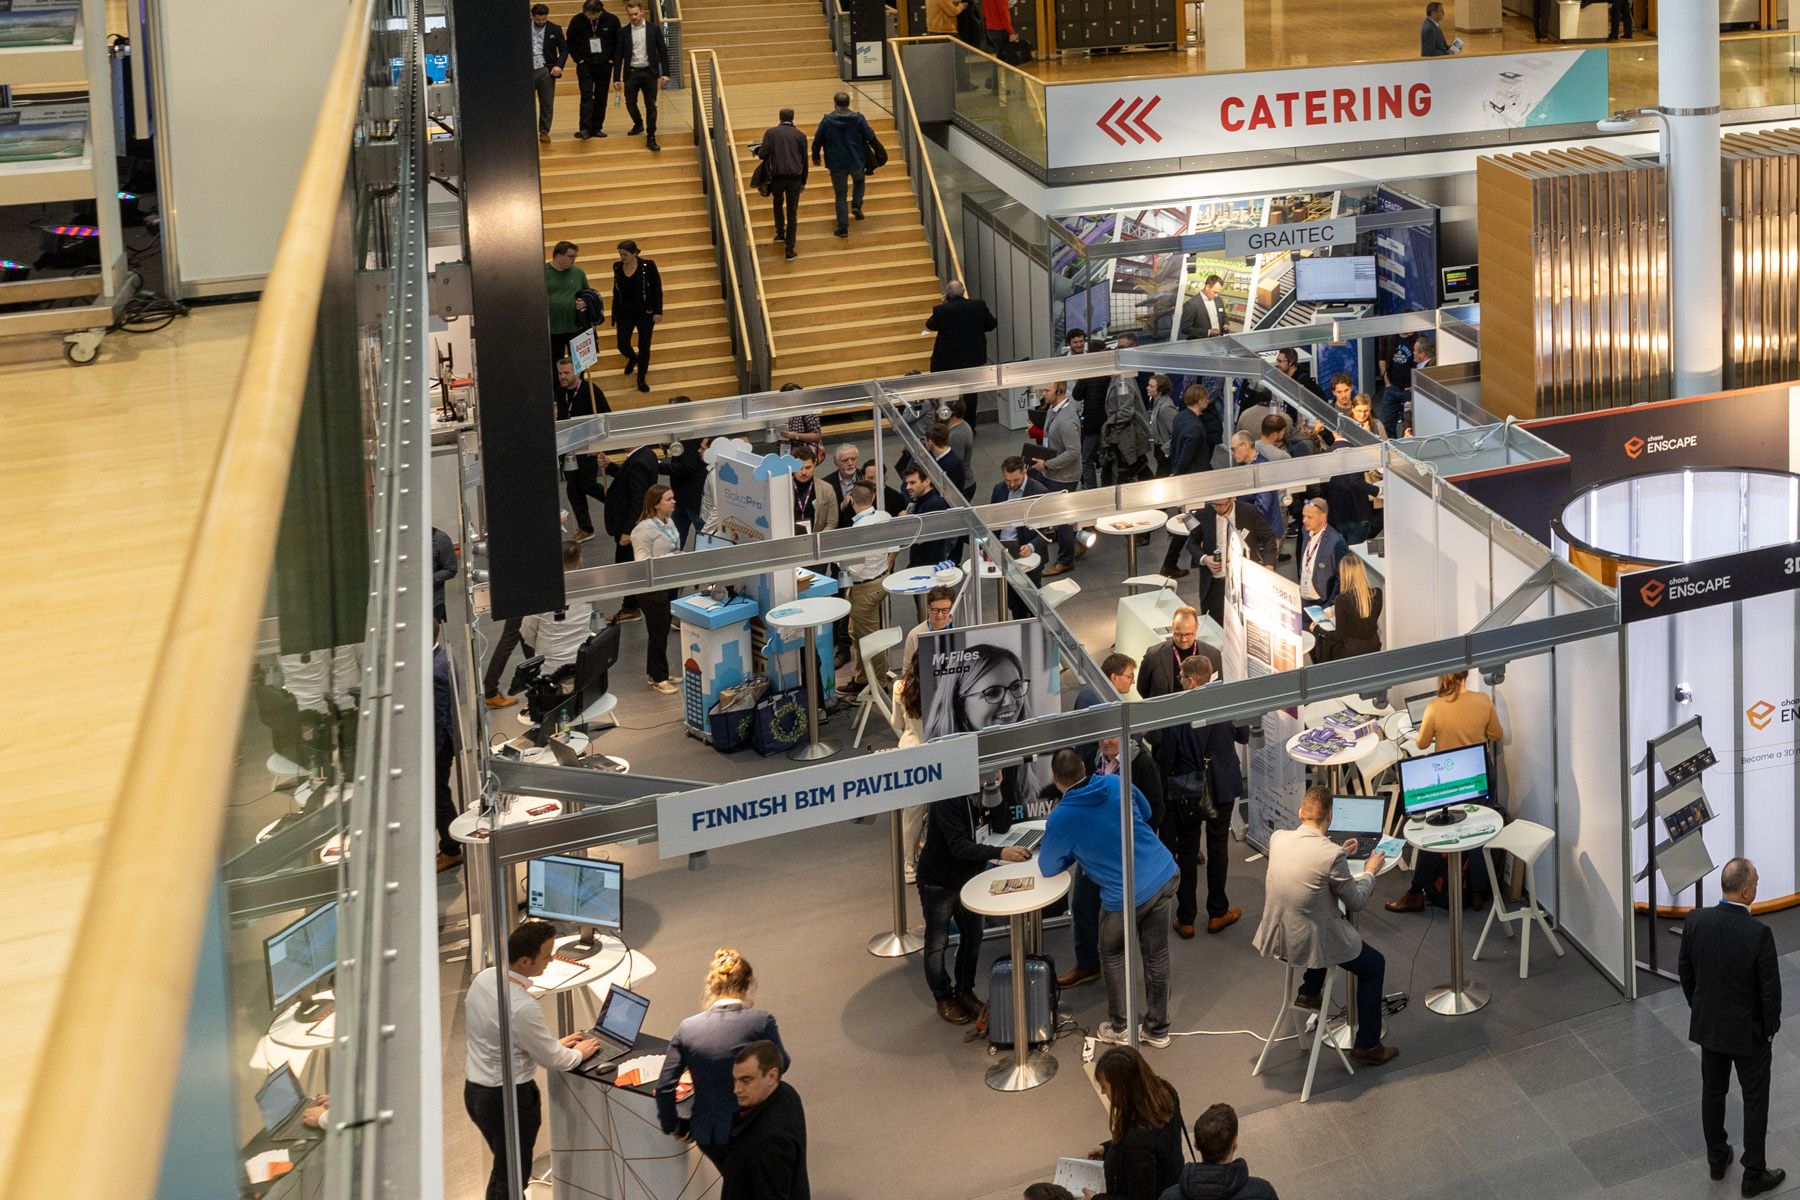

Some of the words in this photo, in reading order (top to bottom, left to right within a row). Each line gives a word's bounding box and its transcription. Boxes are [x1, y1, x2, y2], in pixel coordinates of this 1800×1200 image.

[1220, 82, 1432, 132] CATERING
[1248, 225, 1334, 250] GRAITEC
[576, 338, 592, 352] GUIDED
[579, 346, 590, 358] TOUR
[1647, 436, 1697, 454] ENSCAPE
[724, 488, 763, 510] SokoPro
[1669, 576, 1689, 586] chaos
[1669, 576, 1731, 600] ENSCAPE
[931, 650, 980, 666] M-Files
[1741, 752, 1774, 764] Become
[1784, 748, 1795, 757] 3D
[692, 793, 787, 832] FINNISH
[795, 784, 836, 811] BIM
[843, 762, 943, 800] PAVILION
[1026, 800, 1053, 817] WAY
